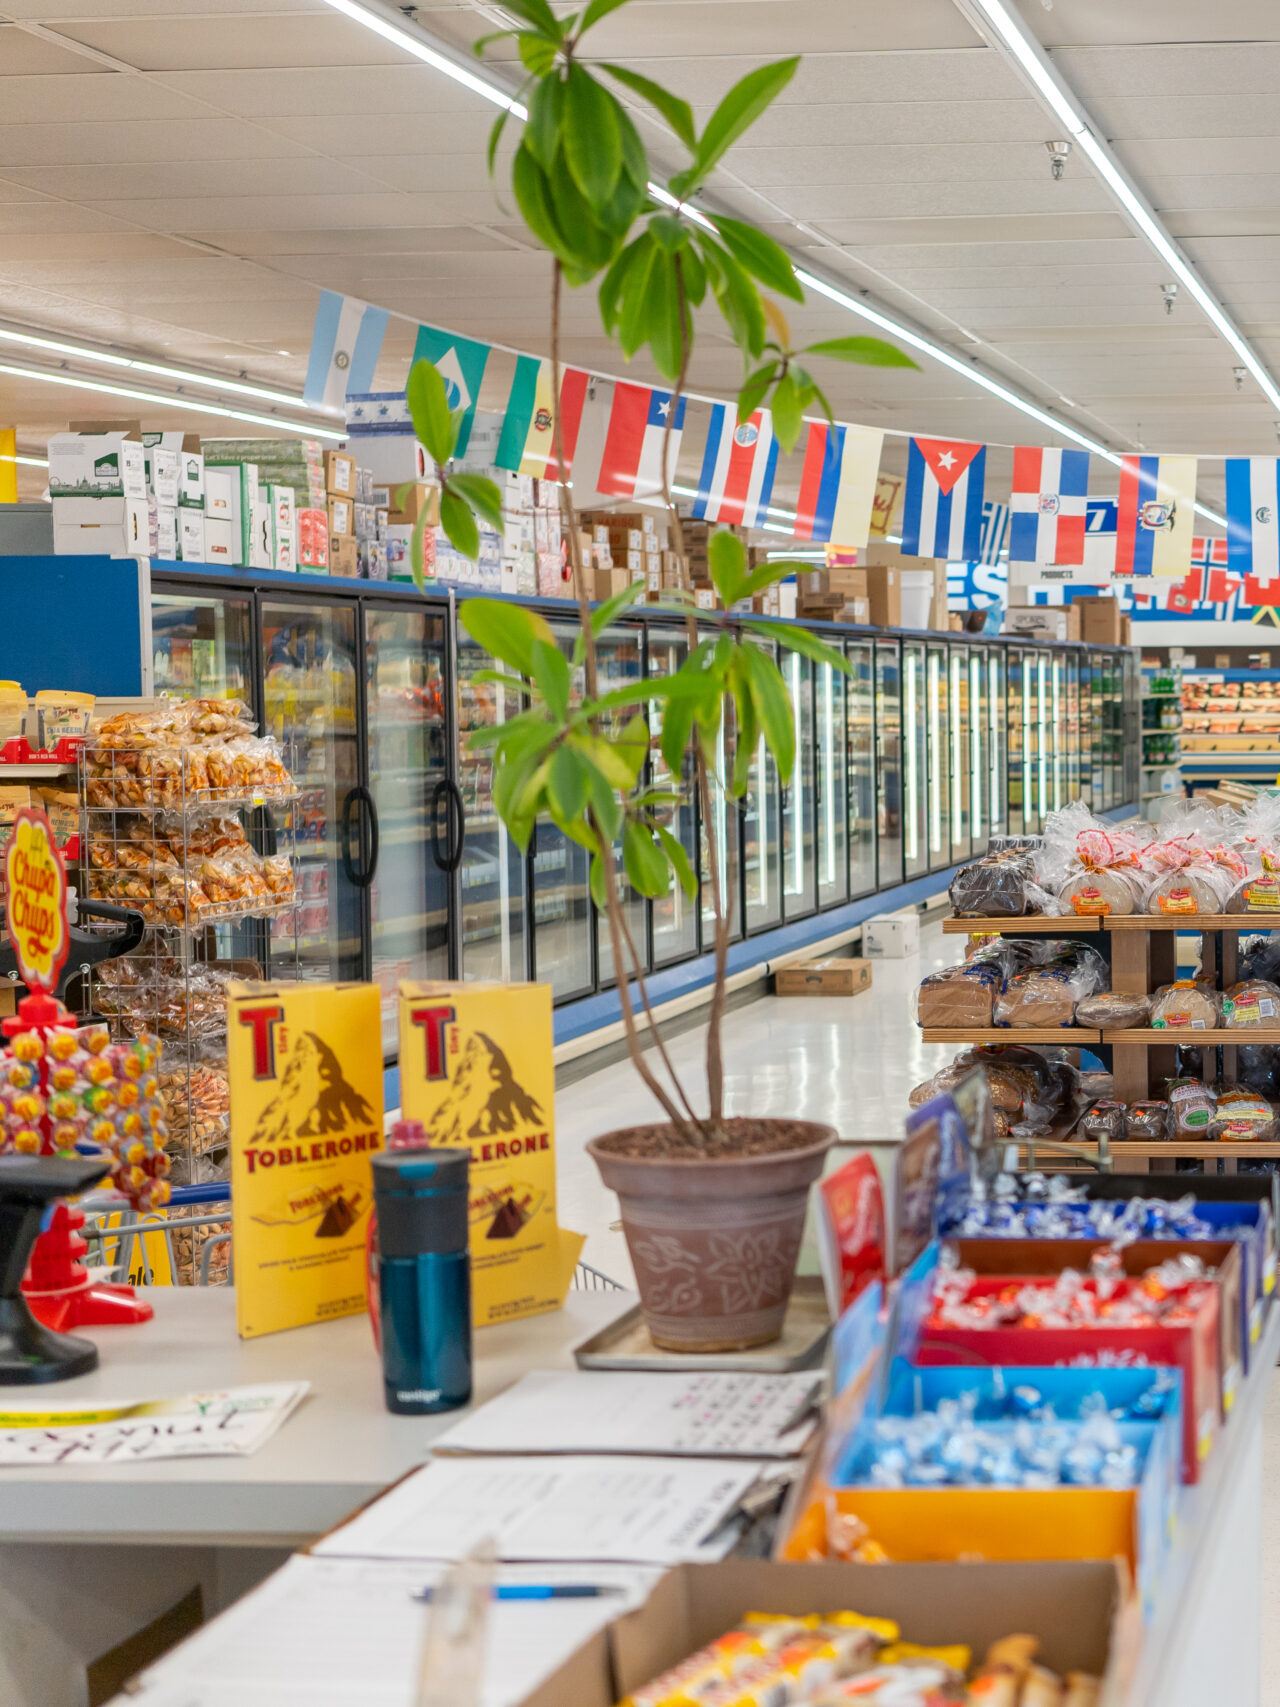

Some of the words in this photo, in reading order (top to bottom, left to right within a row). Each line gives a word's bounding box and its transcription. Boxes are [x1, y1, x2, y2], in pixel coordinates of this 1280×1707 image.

[597, 517, 635, 527] HARIBO
[1041, 570, 1073, 579] PRODUCTS
[14, 850, 56, 902] Chupa
[12, 889, 55, 946] Chups
[238, 1005, 285, 1082] T
[411, 1005, 456, 1082] T
[243, 1131, 380, 1174] TOBLERONE
